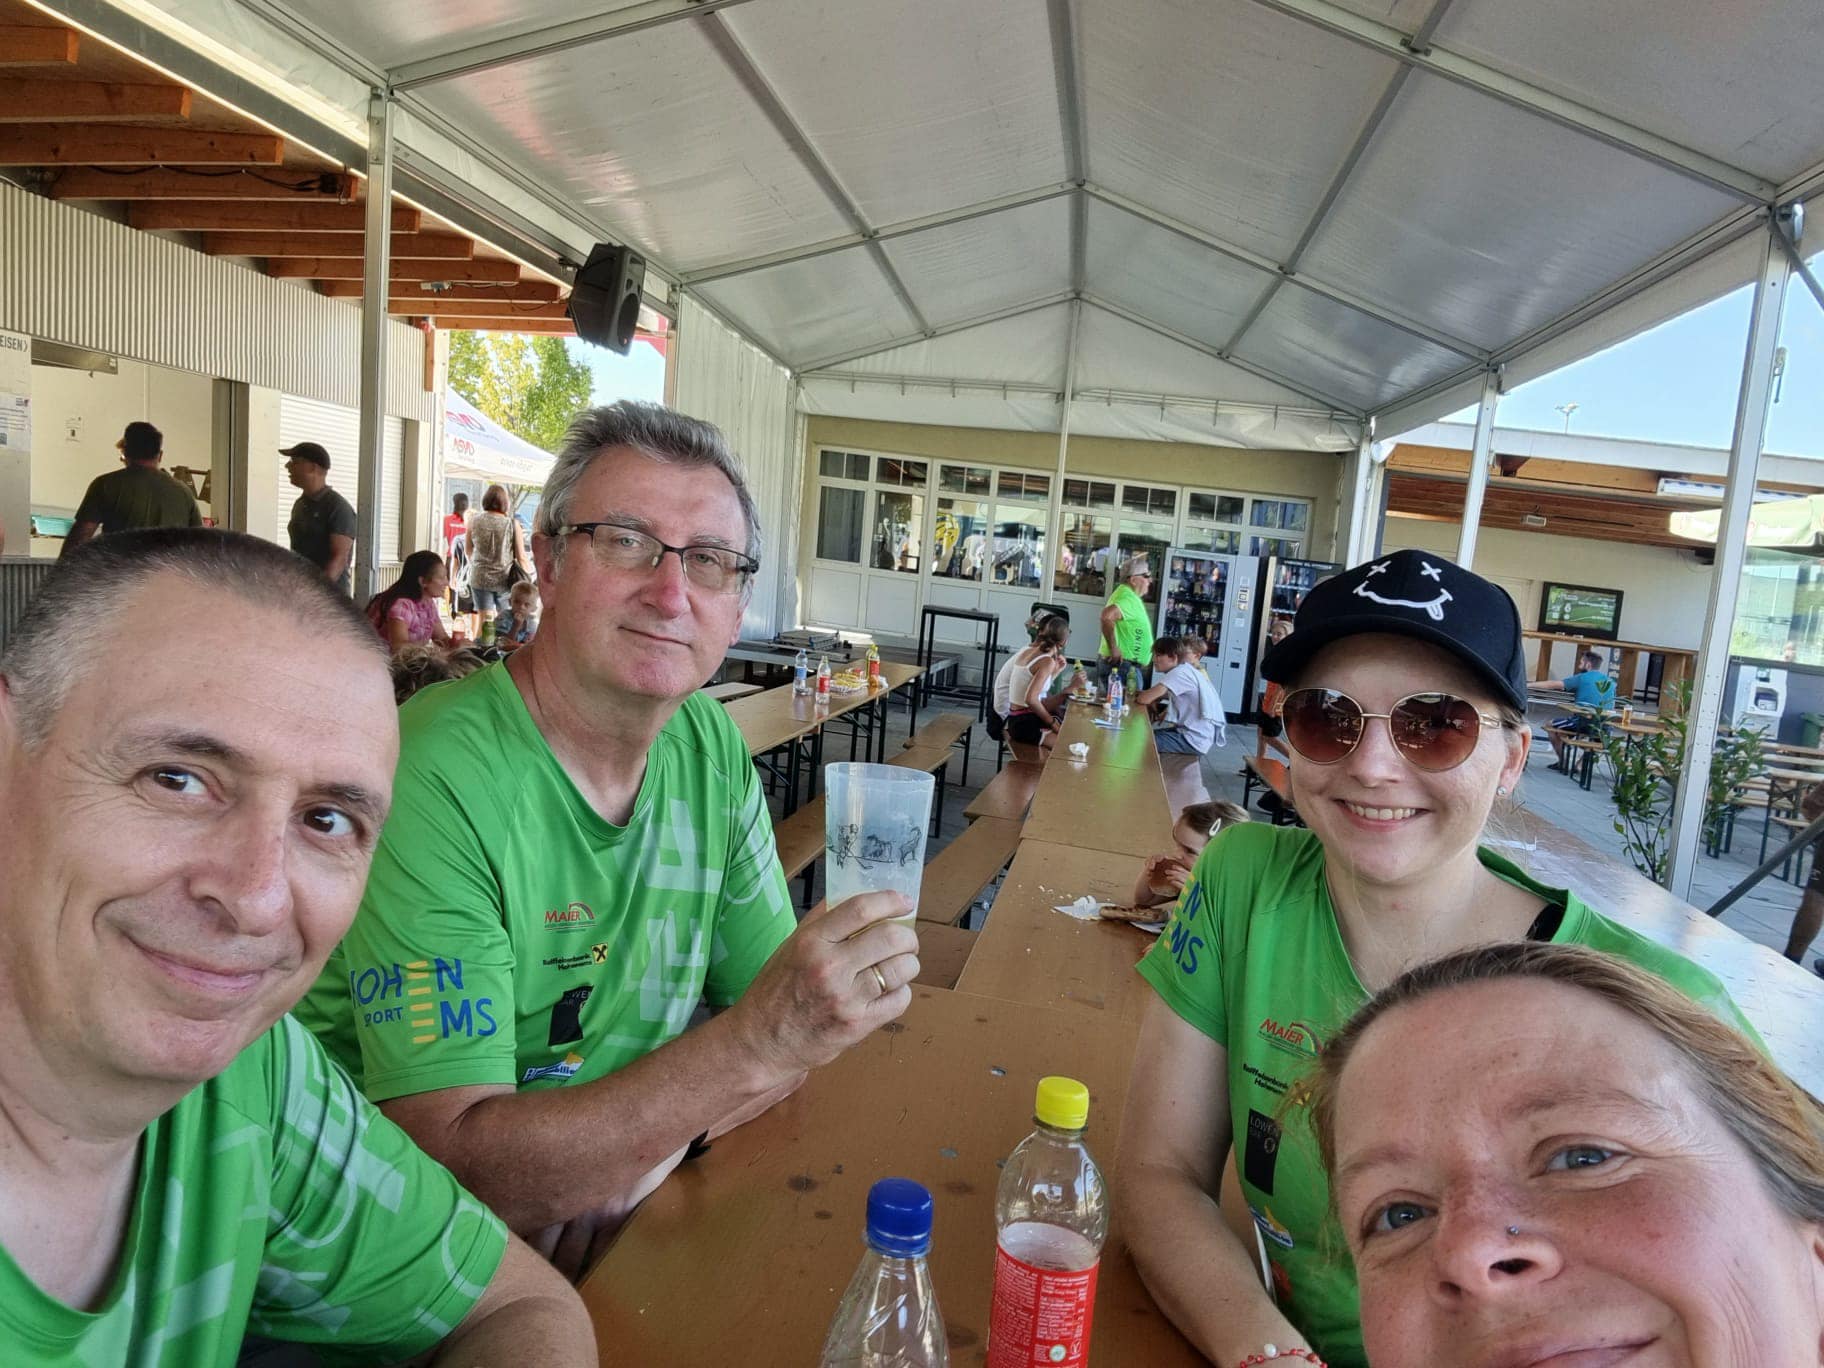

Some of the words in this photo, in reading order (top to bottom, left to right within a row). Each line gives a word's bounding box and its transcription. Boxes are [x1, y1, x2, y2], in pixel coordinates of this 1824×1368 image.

[544, 909, 581, 924] MAIER
[1171, 920, 1205, 975] MS
[1260, 1018, 1305, 1047] MAIER
